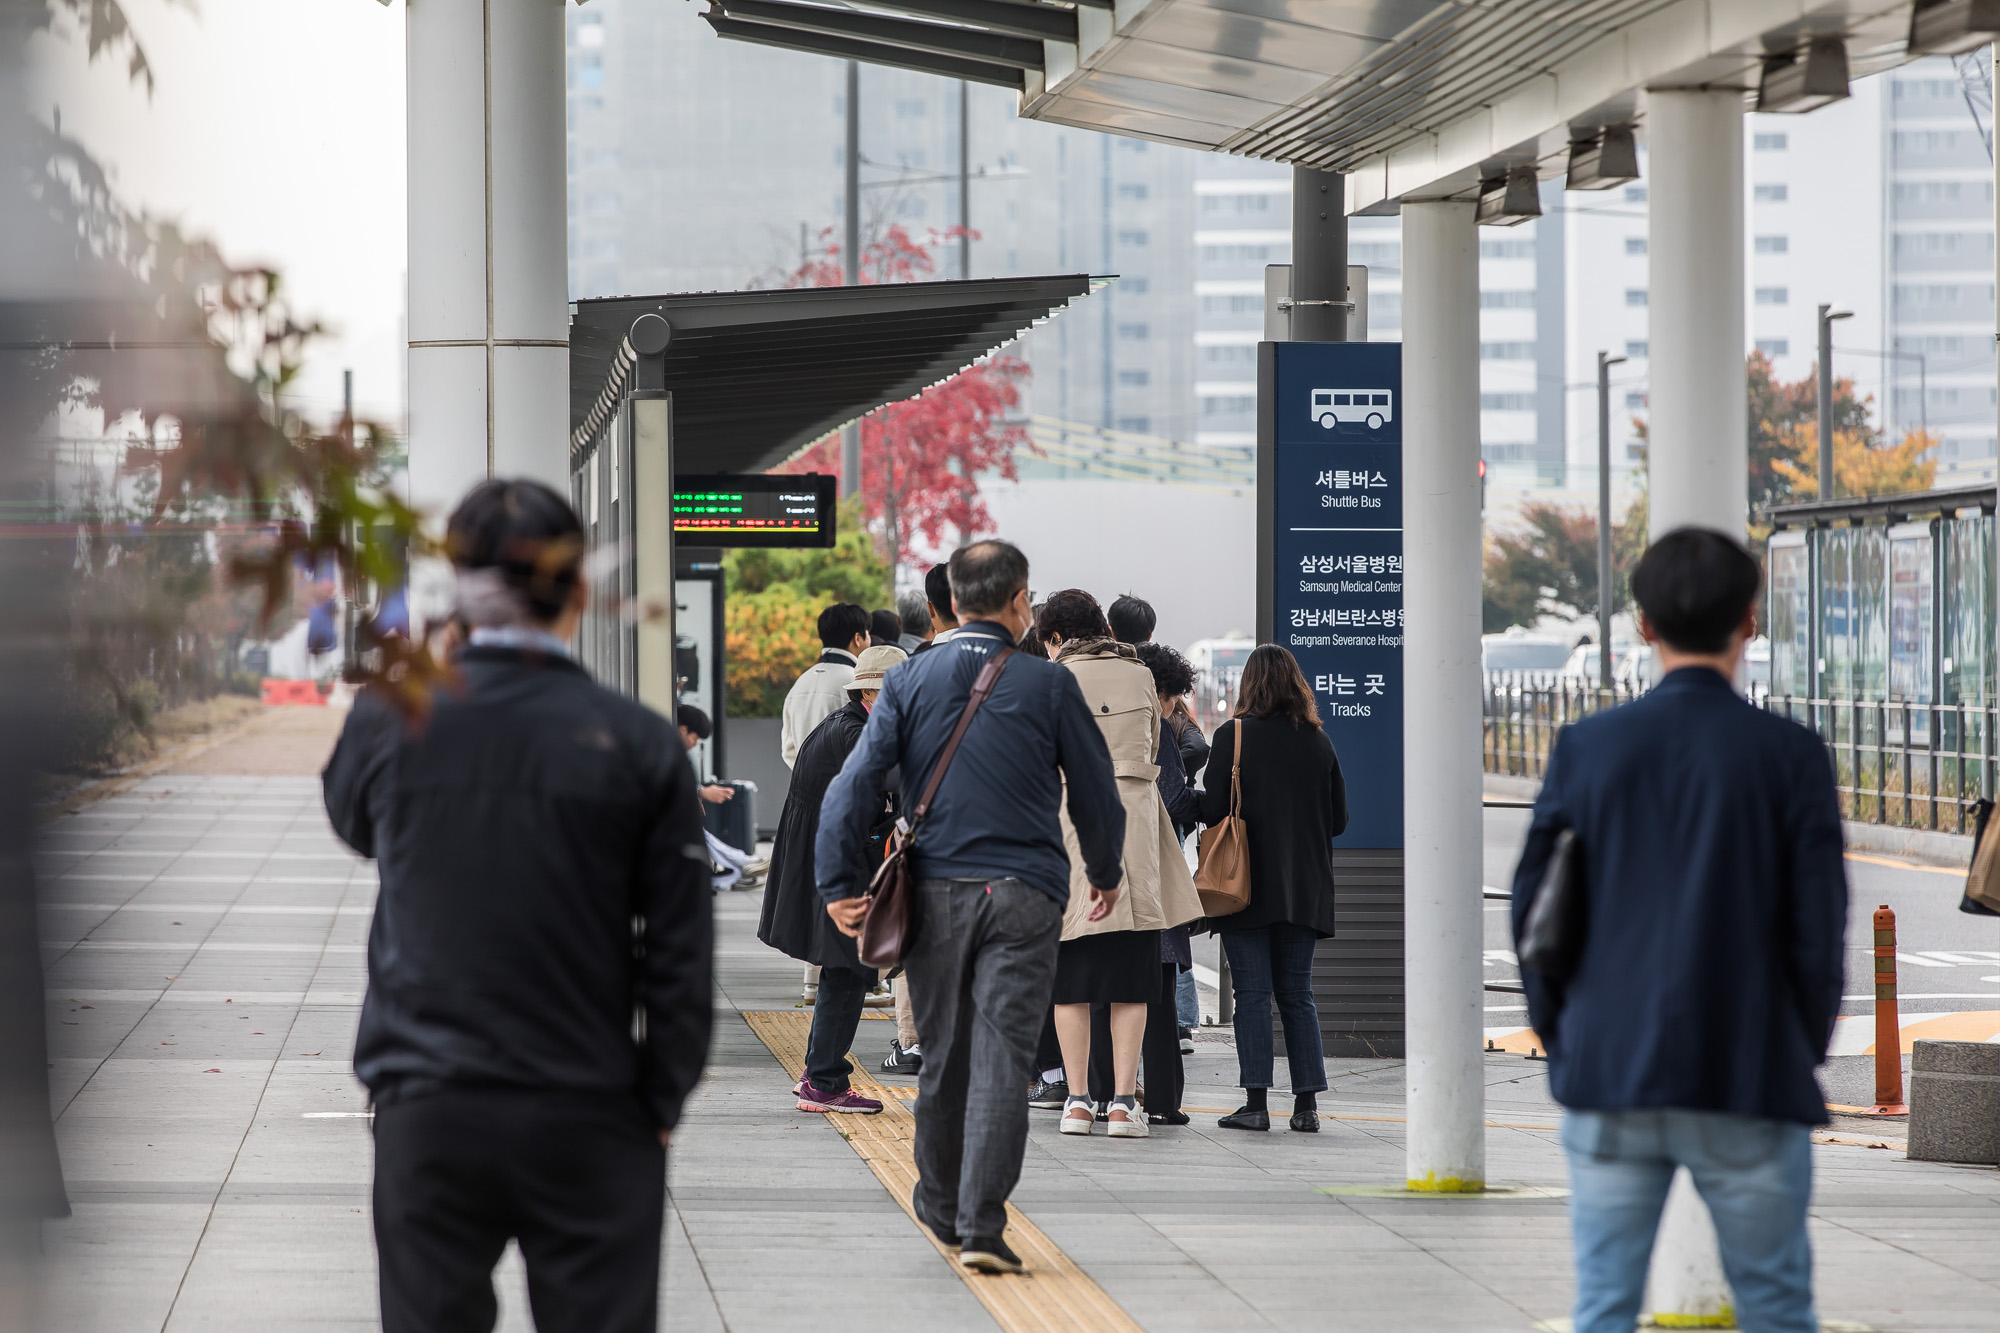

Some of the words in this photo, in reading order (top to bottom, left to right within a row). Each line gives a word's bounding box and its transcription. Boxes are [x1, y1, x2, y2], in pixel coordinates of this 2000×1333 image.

[1315, 470, 1388, 489] 셔틀버스
[1321, 495, 1358, 508] Shuttle
[1361, 495, 1381, 508] Bus
[1300, 555, 1403, 574] 삼성서울병원
[1299, 580, 1339, 595] Samsung
[1340, 580, 1373, 592] Medical
[1374, 580, 1402, 592] Center
[1290, 633, 1330, 648] Gangnam
[1332, 633, 1376, 646] Severance
[1315, 673, 1357, 695] 타는
[1364, 674, 1386, 696] 곳
[1330, 702, 1371, 717] Tracks
